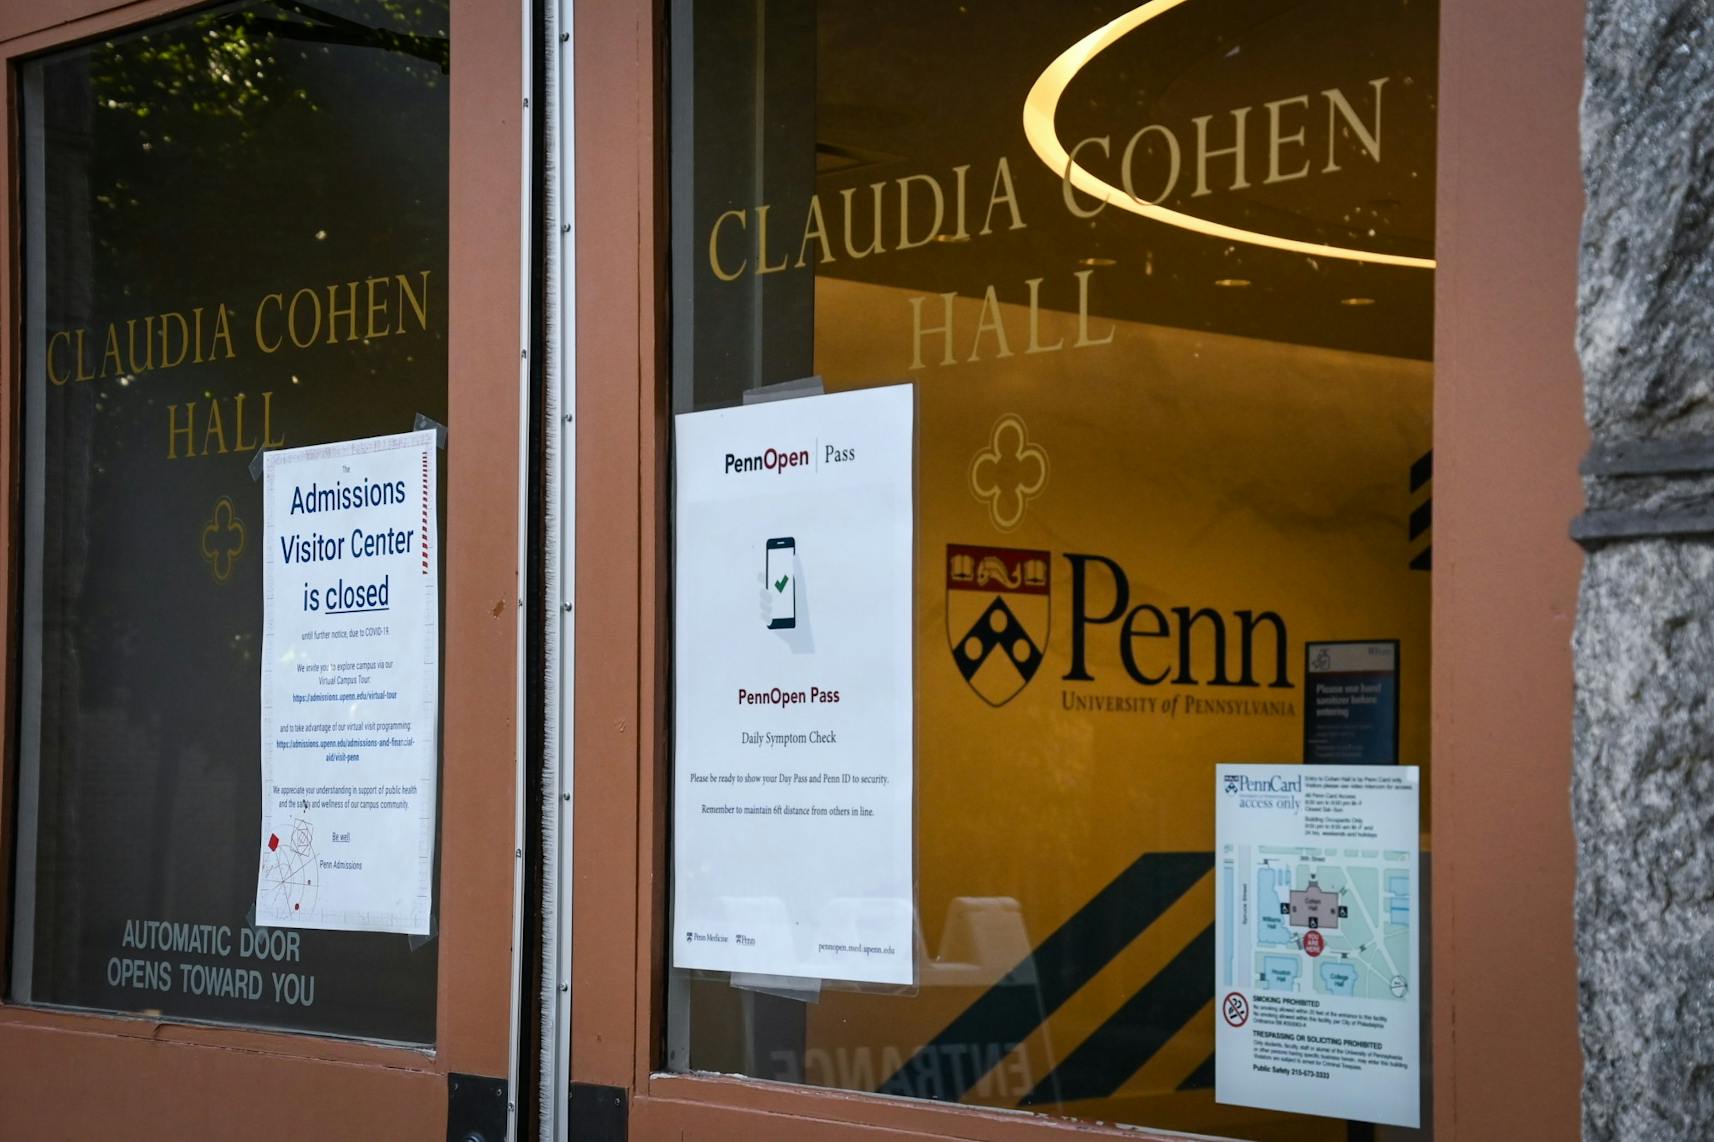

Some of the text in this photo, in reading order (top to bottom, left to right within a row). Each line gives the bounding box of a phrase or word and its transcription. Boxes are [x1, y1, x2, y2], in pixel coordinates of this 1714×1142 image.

[708, 76, 1391, 282] CLAUDIA COHEN
[46, 270, 431, 386] CLAUDIA COHEN
[908, 269, 1117, 370] HALL
[166, 391, 286, 460] HALL
[725, 445, 855, 474] PennOpen Pass
[290, 477, 406, 515] Admissions
[280, 527, 414, 564] Visitor Center
[303, 574, 389, 612] is closed
[1062, 552, 1295, 689] Penn
[301, 630, 313, 640] until
[314, 629, 331, 640] further
[349, 628, 359, 638] due
[359, 628, 365, 637] to
[365, 626, 389, 637] COVID-19
[296, 663, 306, 673] We
[306, 663, 319, 672] invite
[337, 662, 356, 673] explore
[356, 662, 376, 672] campus
[377, 661, 385, 670] via
[385, 661, 393, 669] our
[319, 675, 336, 685] Virtual
[337, 675, 357, 686] Campus
[738, 687, 840, 708] PennOpen Pass
[1062, 691, 1296, 719] UNIVERSITY of PENNSYLVANIA
[280, 723, 289, 733] and
[289, 723, 294, 732] to
[294, 722, 304, 732] take
[305, 722, 331, 733] advantage
[332, 722, 337, 731] of
[338, 723, 346, 732] our
[347, 722, 364, 732] virtual
[364, 721, 376, 731] visit
[741, 731, 837, 747] Daily Symptom Check
[690, 773, 889, 786] Please be ready to show your Day Pass and Penn ID to security.
[1240, 775, 1302, 793] PennCard
[272, 785, 417, 796] We appreciate your understanding in support of public health
[278, 800, 288, 808] and
[288, 800, 296, 808] the
[311, 800, 321, 808] and
[321, 799, 344, 809] wellness
[345, 799, 350, 809] of
[351, 801, 360, 809] our
[360, 802, 379, 810] campus
[701, 804, 875, 816] Remember to maintain 6ft distance from others in line.
[1239, 799, 1273, 809] access
[1276, 796, 1300, 815] only
[319, 860, 362, 870] Penn Admissions
[122, 919, 300, 962] AUTOMATIC DOOR
[107, 957, 315, 1006] OPENS TOWARD YOU
[1253, 995, 1320, 1008] SMOKING PROHIBITED
[1252, 1030, 1295, 1041] TRESPASSING
[1295, 1034, 1306, 1042] OR
[1306, 1035, 1342, 1046] SOLICITING
[1343, 1039, 1383, 1050] PROHIBITED
[1252, 1064, 1271, 1073] Public
[1272, 1066, 1290, 1076] Safety
